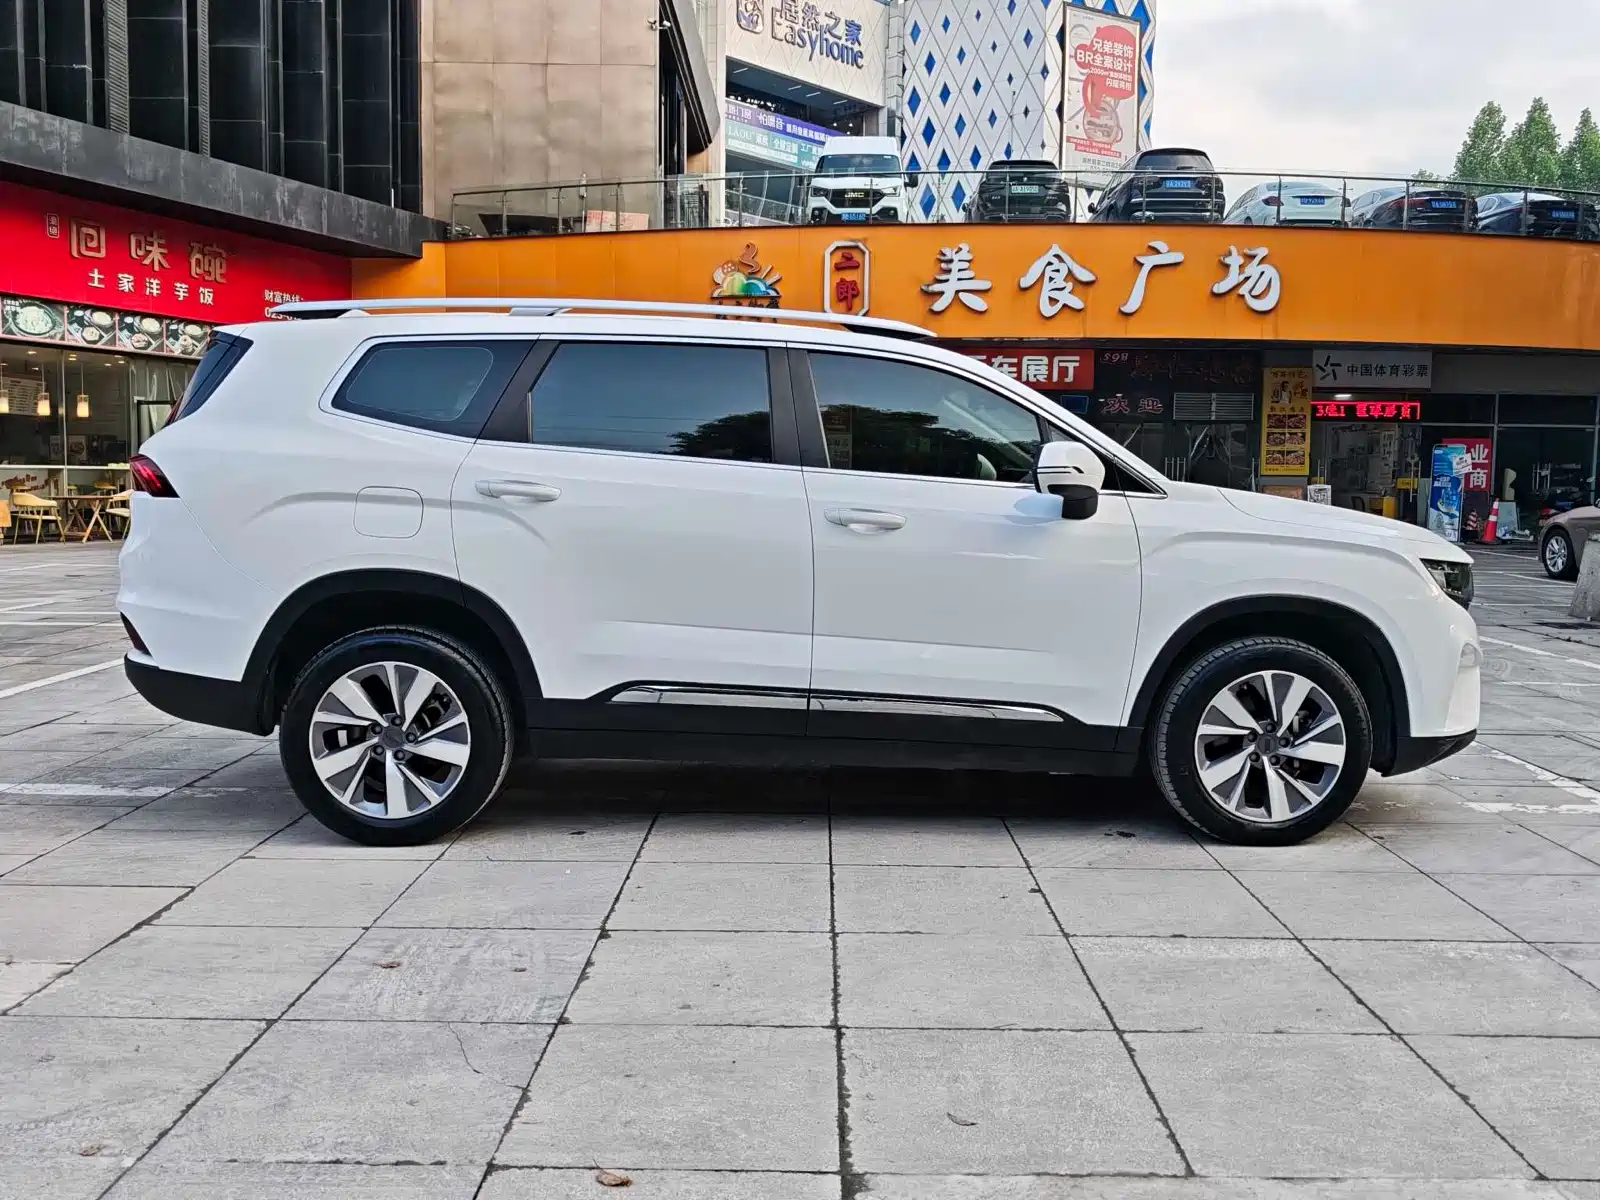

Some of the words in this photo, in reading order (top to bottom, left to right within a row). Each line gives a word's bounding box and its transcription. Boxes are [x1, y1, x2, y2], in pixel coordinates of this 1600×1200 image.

[772, 7, 864, 69] Easyhome
[780, 0, 861, 46] 居然之家
[1093, 38, 1134, 59] 兄弟装饰
[70, 219, 228, 283] 回味碗
[88, 268, 214, 306] 土家洋芋饭
[834, 251, 860, 312] 二郎
[919, 241, 1281, 319] 美食广场
[968, 355, 1081, 383] 车展厅
[1346, 363, 1429, 378] 中国体育彩票
